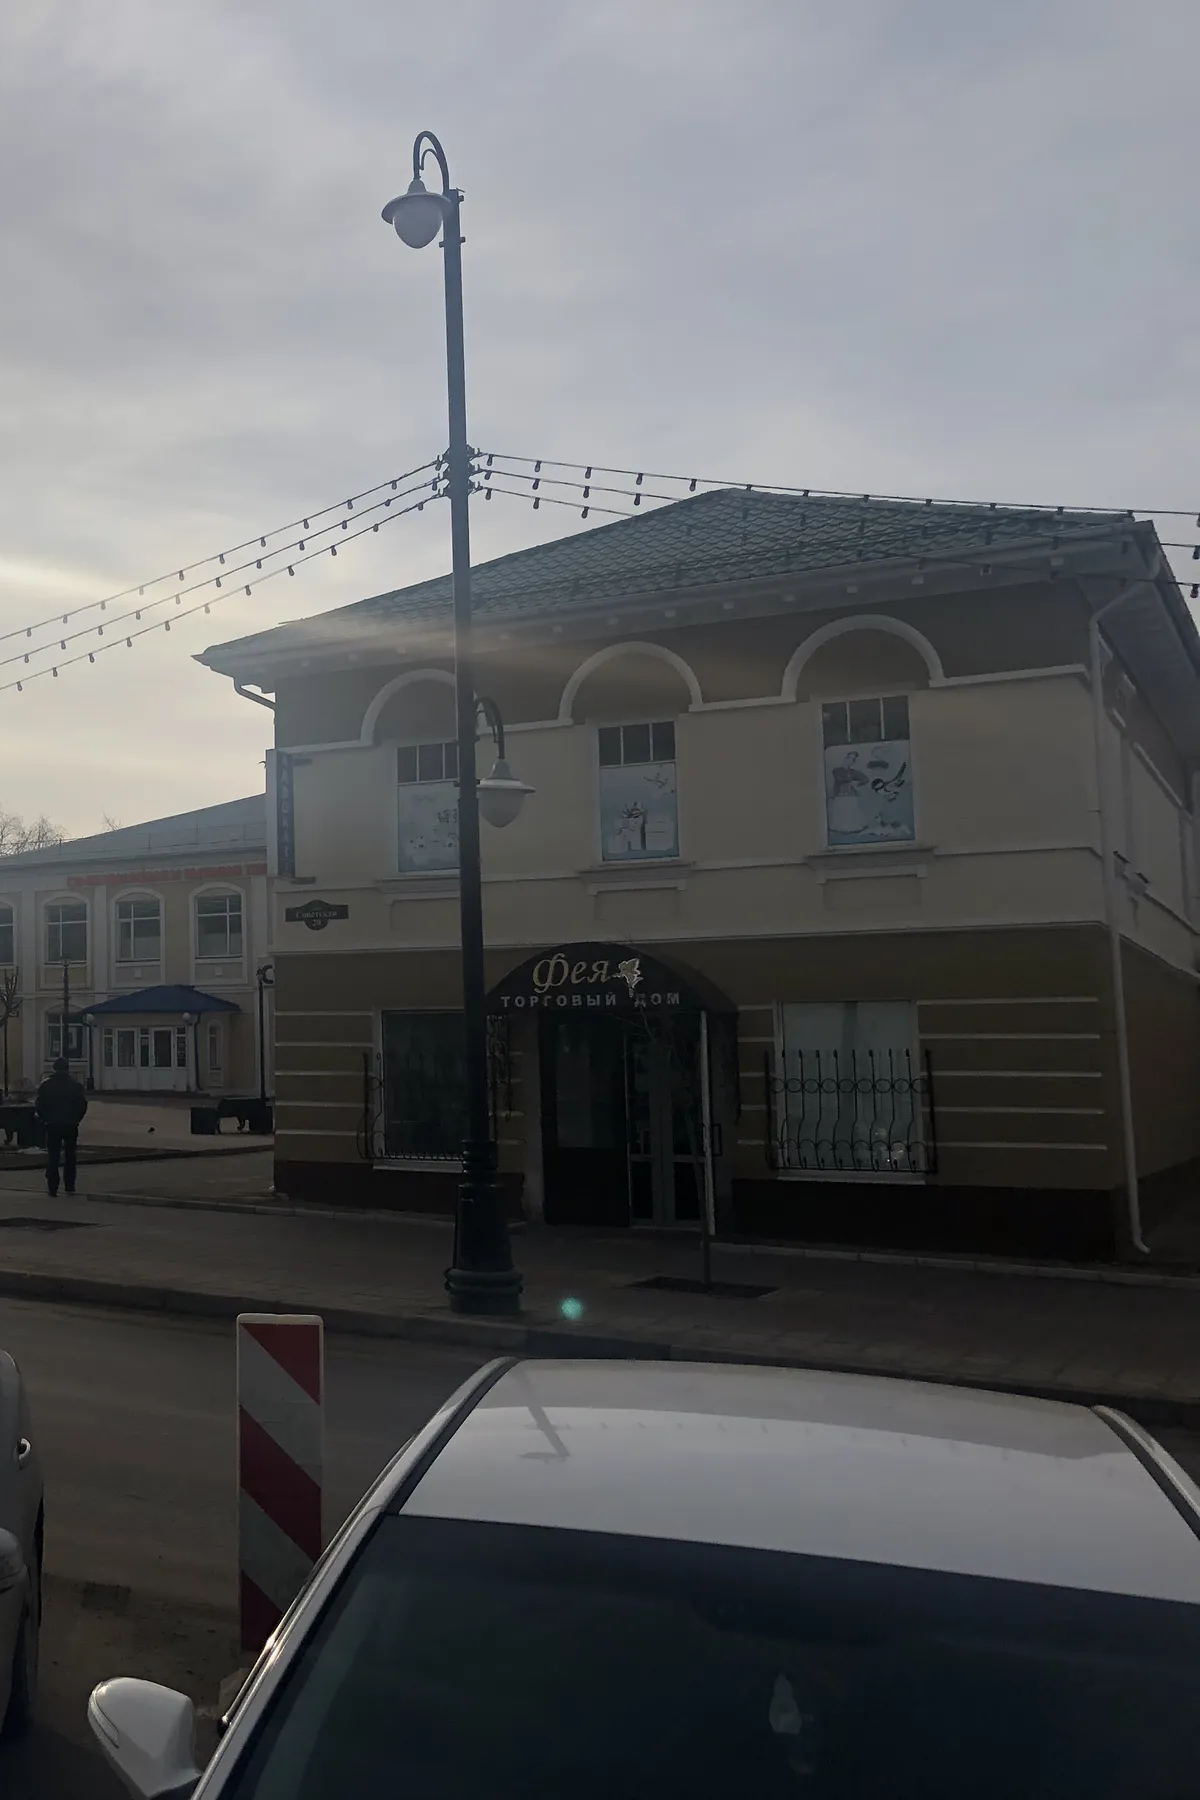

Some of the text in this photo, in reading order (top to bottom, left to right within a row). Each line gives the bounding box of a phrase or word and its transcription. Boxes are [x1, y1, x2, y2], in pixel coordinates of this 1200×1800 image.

[532, 953, 610, 993] Фея
[500, 992, 680, 1008] ТОРГОВЫЙ ДОМ
